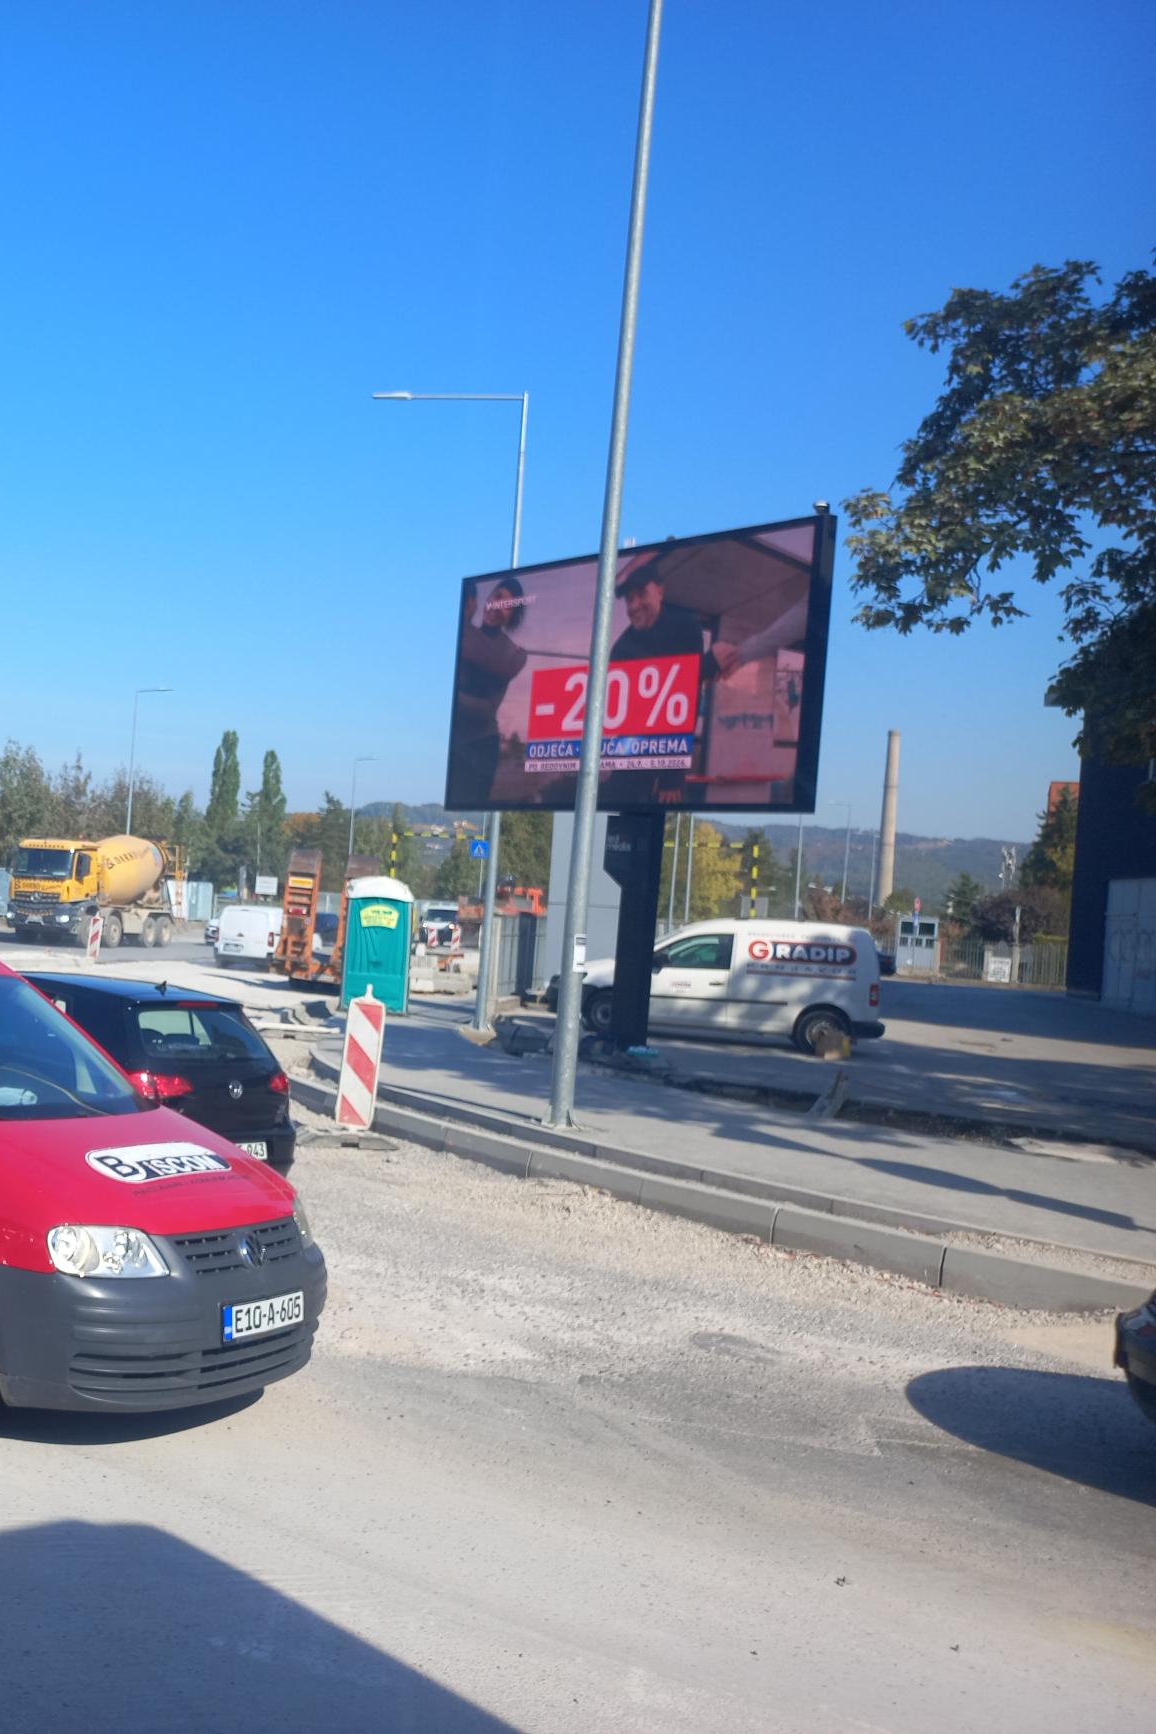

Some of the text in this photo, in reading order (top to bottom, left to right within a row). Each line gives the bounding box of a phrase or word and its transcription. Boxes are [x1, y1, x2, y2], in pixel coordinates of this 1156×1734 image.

[631, 738, 688, 754] OPREMA
[748, 940, 850, 963] GRADIP
[235, 1296, 301, 1333] E10-A-605
